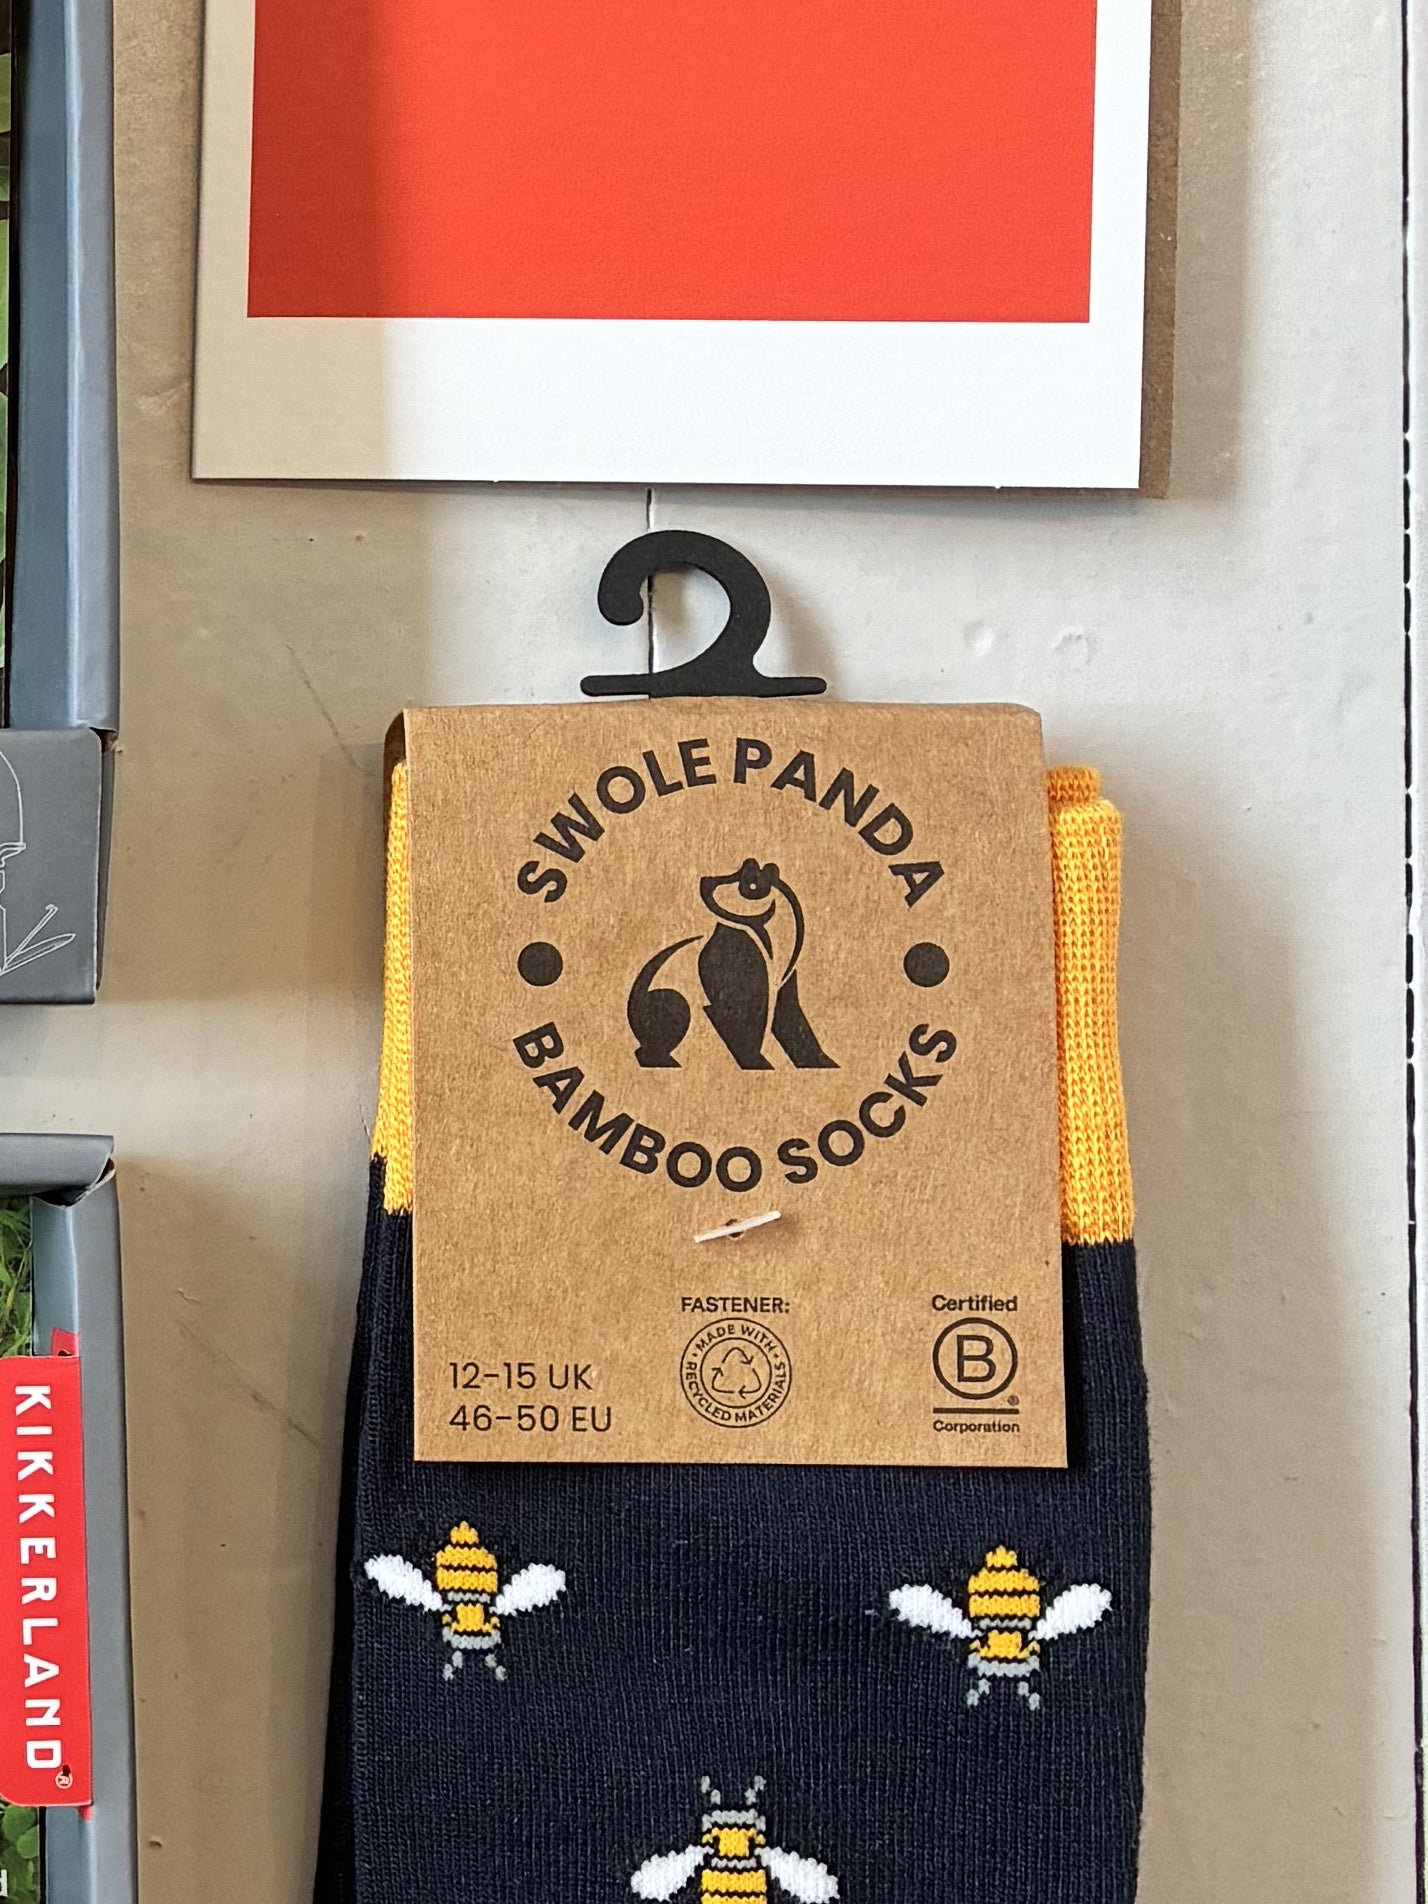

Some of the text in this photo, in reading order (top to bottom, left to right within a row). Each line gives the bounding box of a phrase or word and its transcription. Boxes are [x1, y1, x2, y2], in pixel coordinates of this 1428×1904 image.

[517, 737, 945, 907] SWOLE PANDA
[513, 1021, 957, 1192] BAMBOO SOCKS
[681, 1297, 790, 1313] FASTENER:
[932, 1295, 1018, 1311] Certified
[695, 1324, 776, 1353] MADE WITH
[957, 1335, 996, 1383] B
[450, 1362, 592, 1389] 12-15 UK
[686, 1361, 786, 1423] RECYCLED MATERIALS
[450, 1405, 611, 1432] 46-50 EU
[933, 1420, 1019, 1434] Corporation
